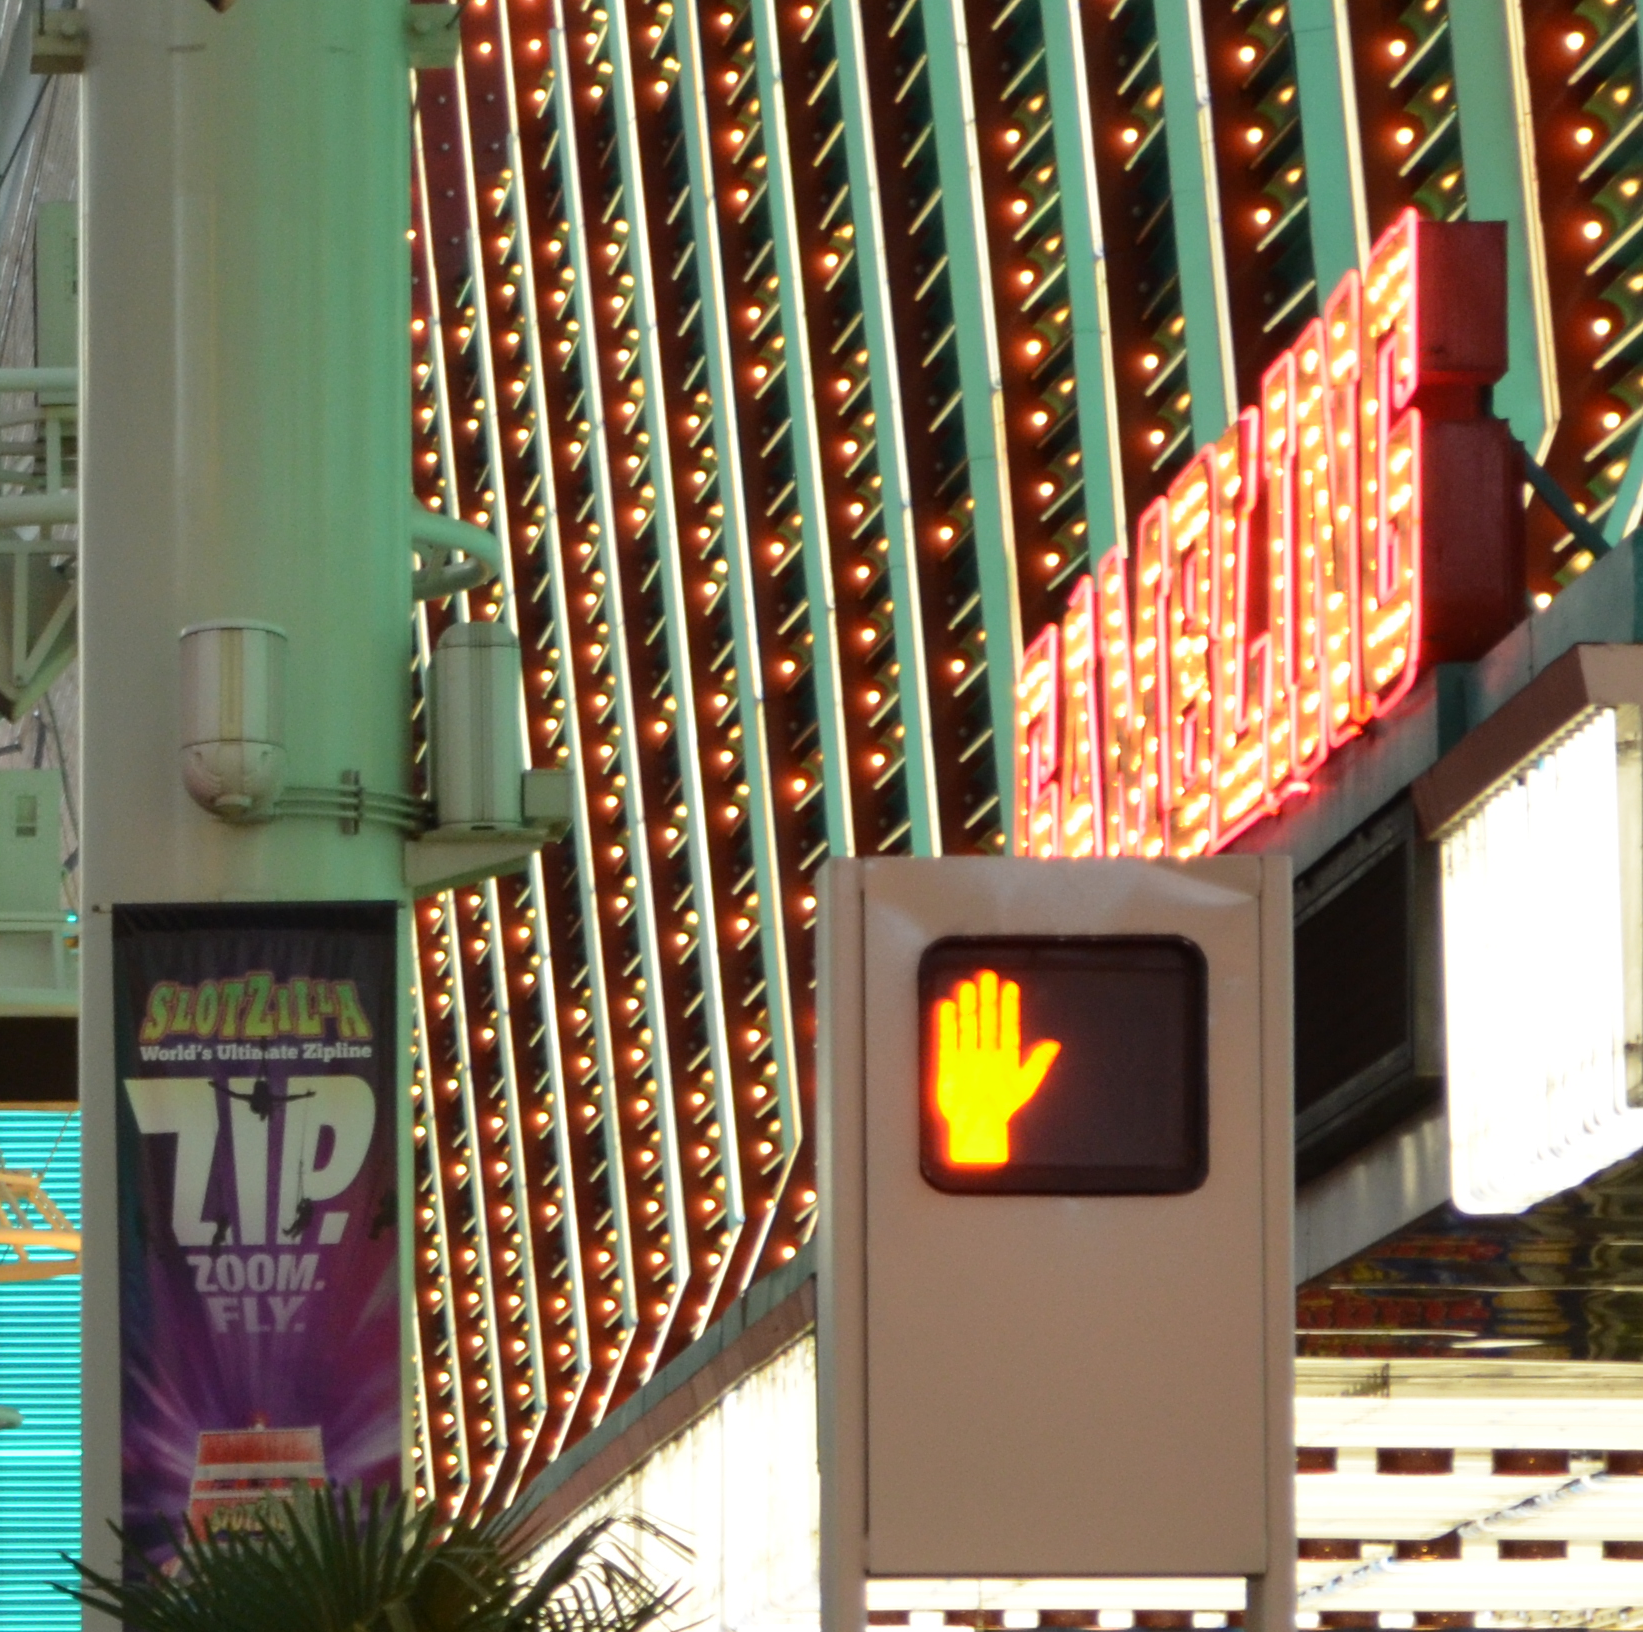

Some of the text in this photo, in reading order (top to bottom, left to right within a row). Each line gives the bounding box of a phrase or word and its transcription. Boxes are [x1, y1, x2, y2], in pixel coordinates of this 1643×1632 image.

[1014, 208, 1421, 858] GAMBLING
[139, 970, 373, 1042] SLOTZILLA
[140, 1043, 372, 1063] World's Ultimate Zipline
[123, 1074, 376, 1247] ZIP.
[186, 1254, 325, 1293] ZOOM.
[207, 1296, 307, 1334] FLY.
